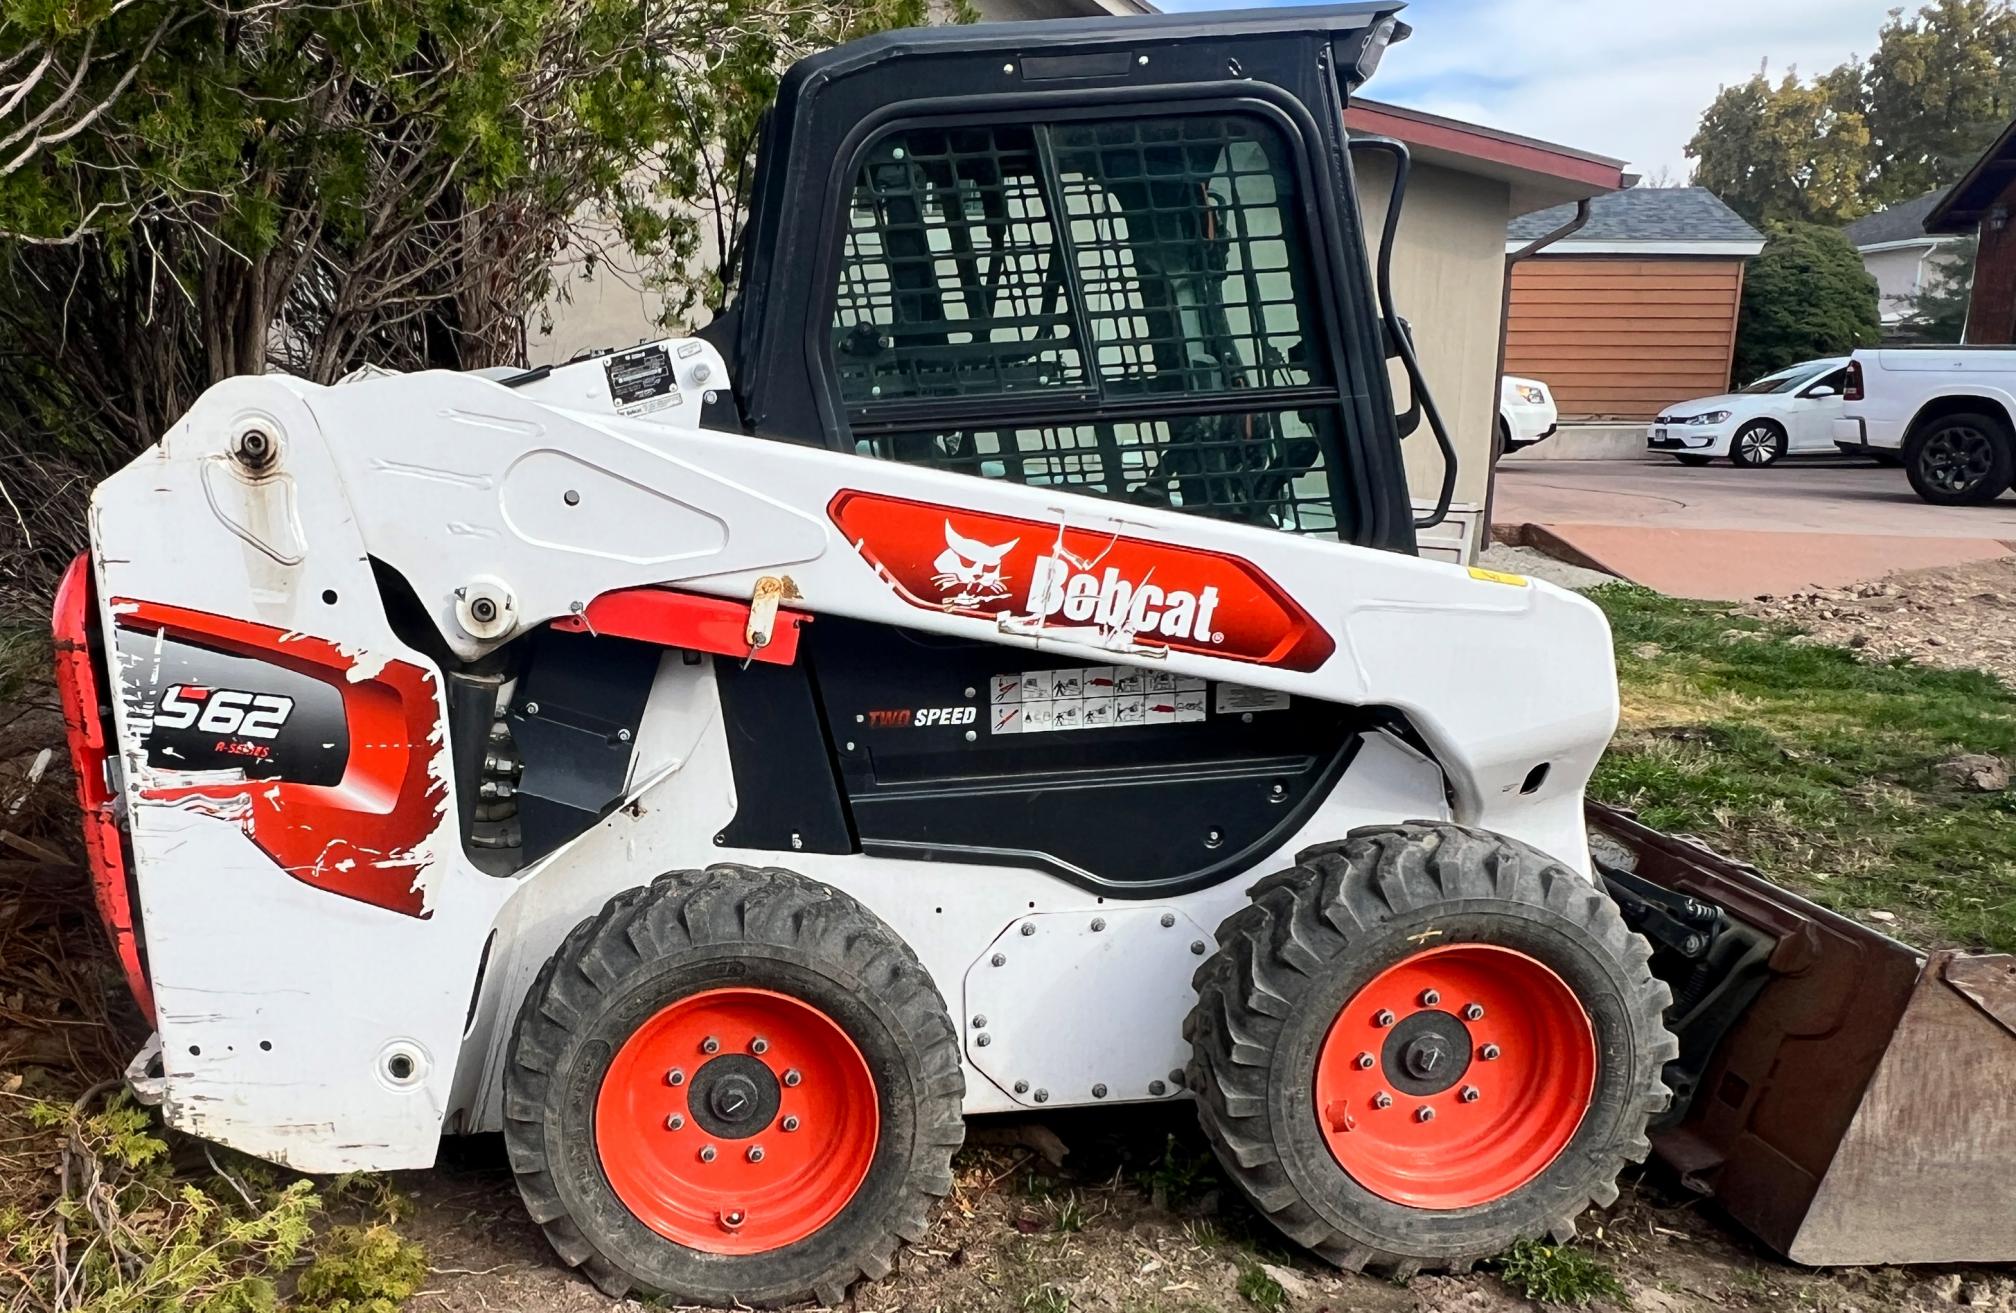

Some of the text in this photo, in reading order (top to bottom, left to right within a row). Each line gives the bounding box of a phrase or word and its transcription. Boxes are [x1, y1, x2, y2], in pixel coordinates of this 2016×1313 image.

[154, 685, 294, 738] S62
[869, 706, 977, 728] TWO SPEED
